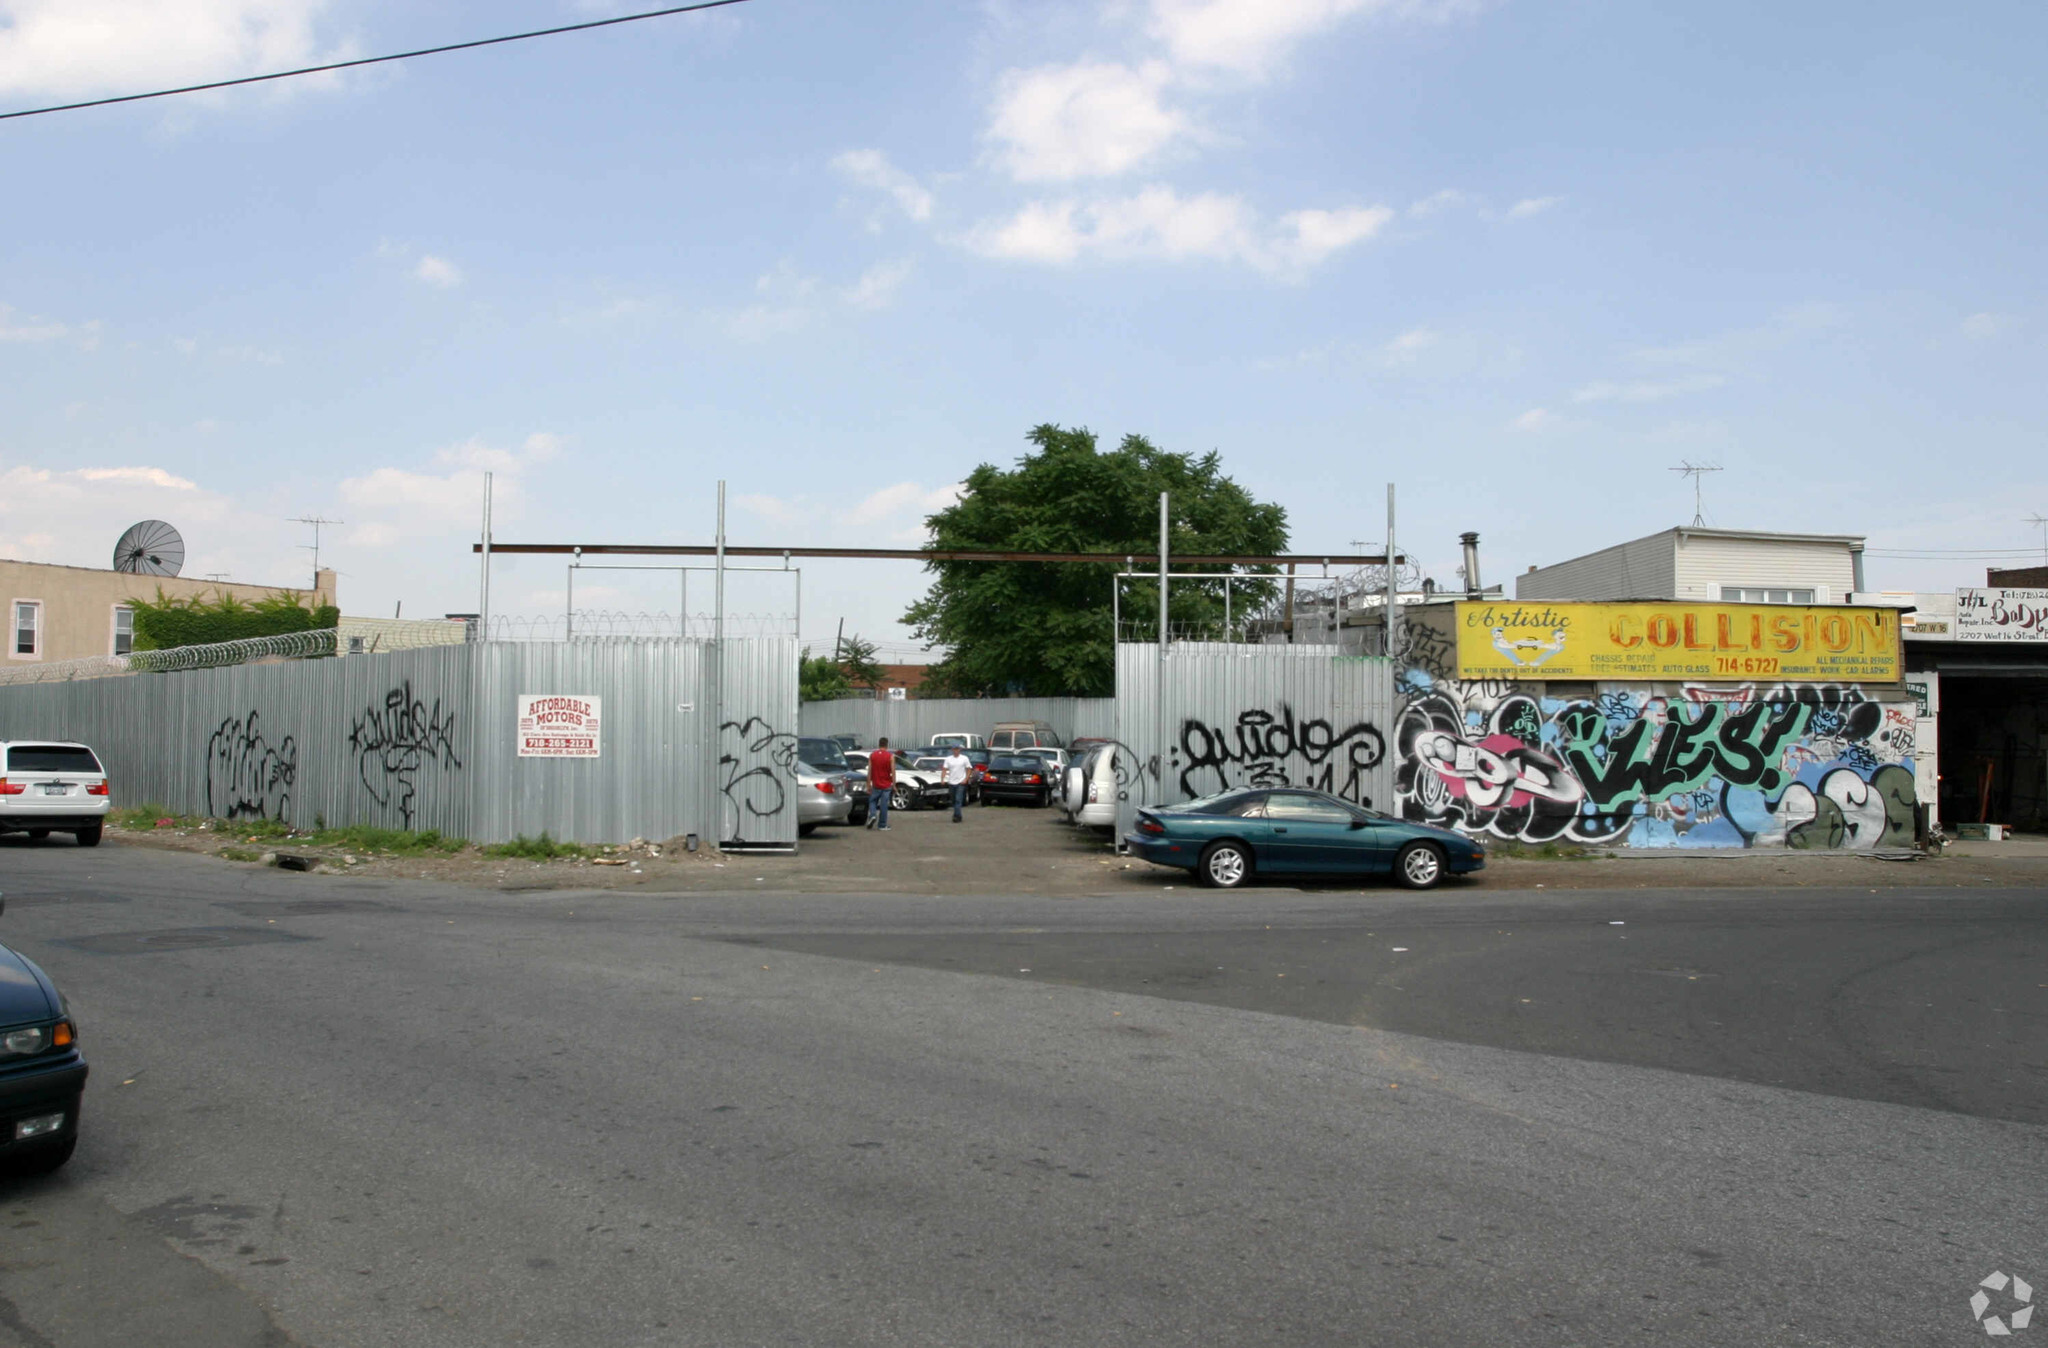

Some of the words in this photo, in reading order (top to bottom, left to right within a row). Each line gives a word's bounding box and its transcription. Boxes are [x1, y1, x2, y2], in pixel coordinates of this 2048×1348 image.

[1467, 607, 1571, 628] Artistic
[1929, 624, 1936, 632] W
[1609, 613, 1888, 653] COLLISION
[1816, 656, 1828, 664] ALL
[1662, 665, 1683, 673] AUTO
[1685, 665, 1710, 673] GLASS
[1781, 666, 1816, 674] INSURANCE
[1820, 666, 1840, 674] WORK
[1846, 666, 1859, 674] CAR
[529, 697, 591, 716] AFFORDABLE
[536, 711, 582, 726] MOTORS
[528, 739, 590, 747] 718-265-2121
